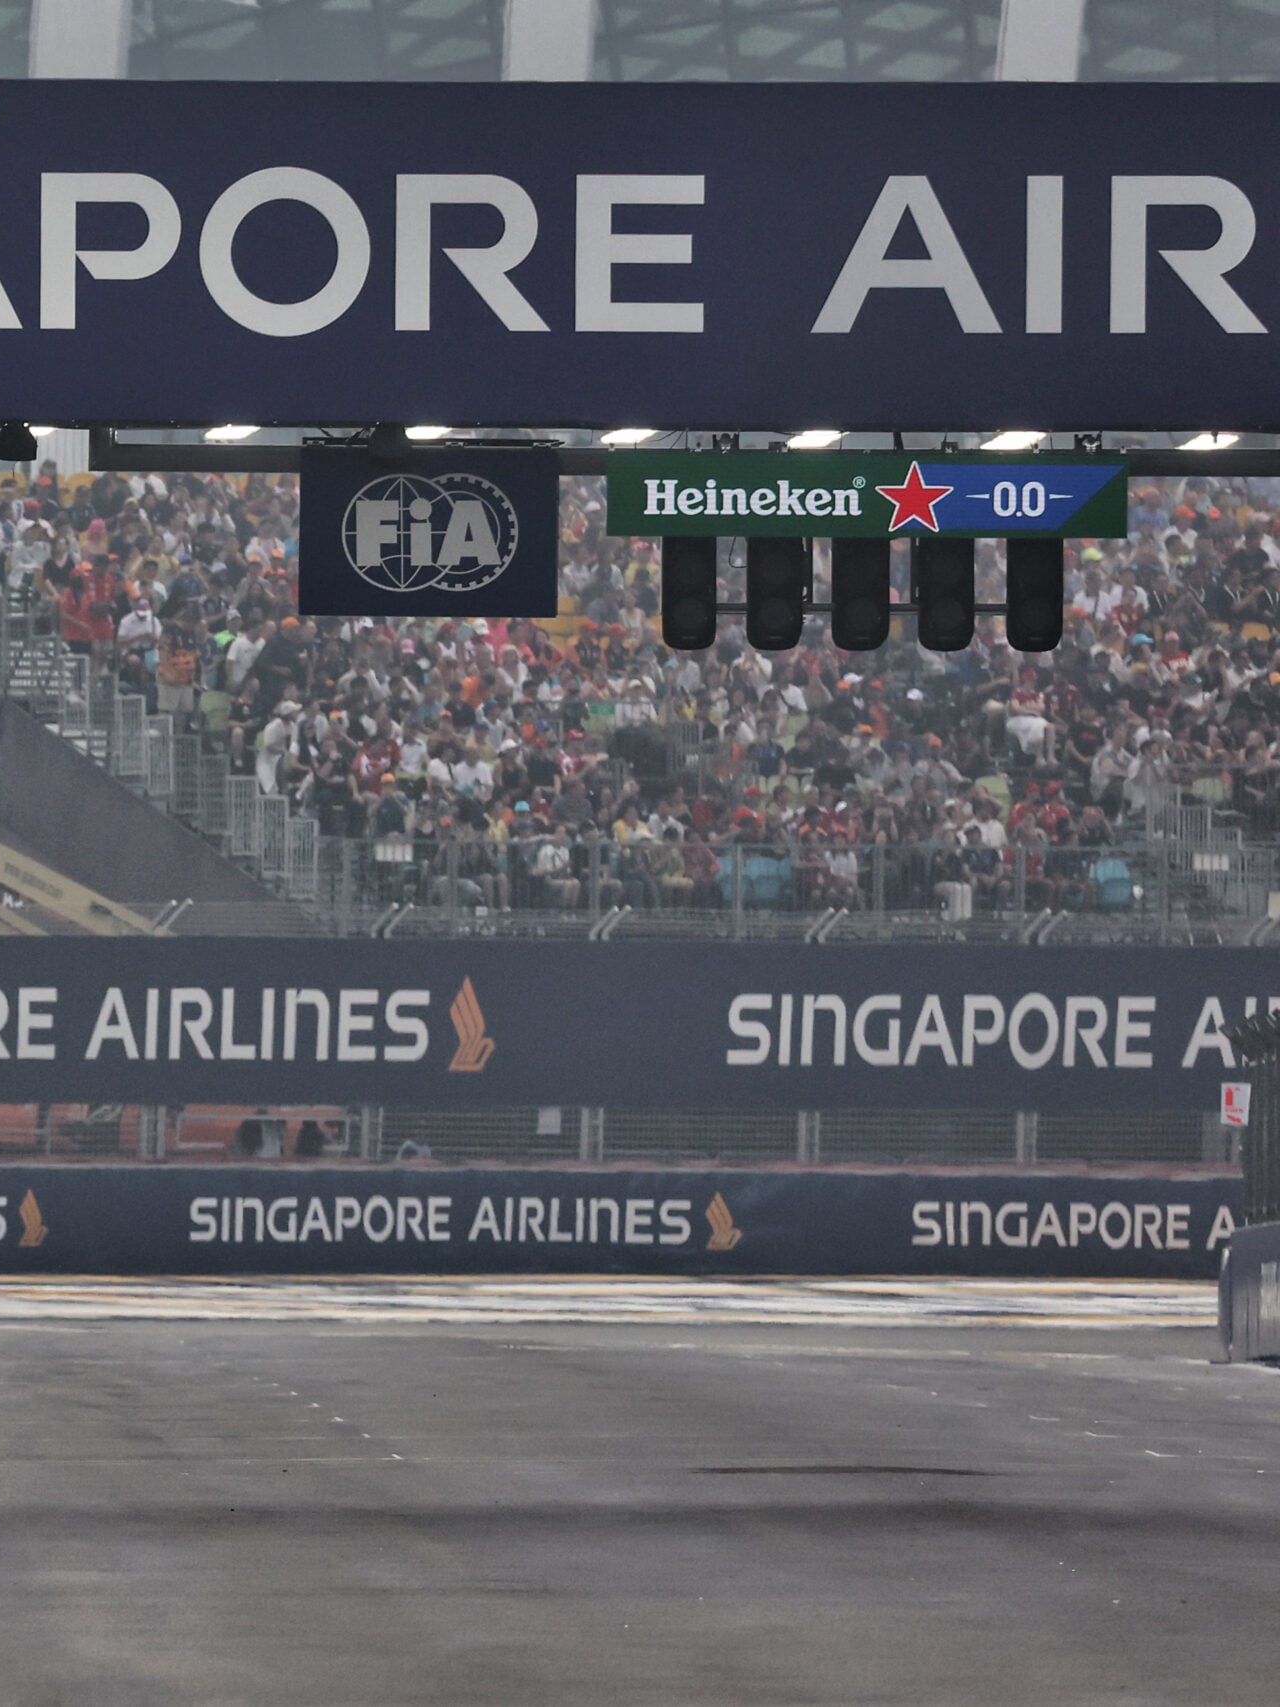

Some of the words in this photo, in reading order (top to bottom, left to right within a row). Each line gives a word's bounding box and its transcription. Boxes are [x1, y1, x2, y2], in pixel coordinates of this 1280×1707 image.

[811, 174, 1269, 334] AIR
[643, 478, 862, 517] Heineken
[993, 481, 1045, 517] 0.0
[85, 986, 431, 1062] AIRLINES
[726, 992, 1156, 1070] SINGAPORE
[189, 1195, 452, 1243] SINGAPORE
[468, 1196, 692, 1245] AIRLINES
[912, 1201, 1191, 1249] SINGAPORE
